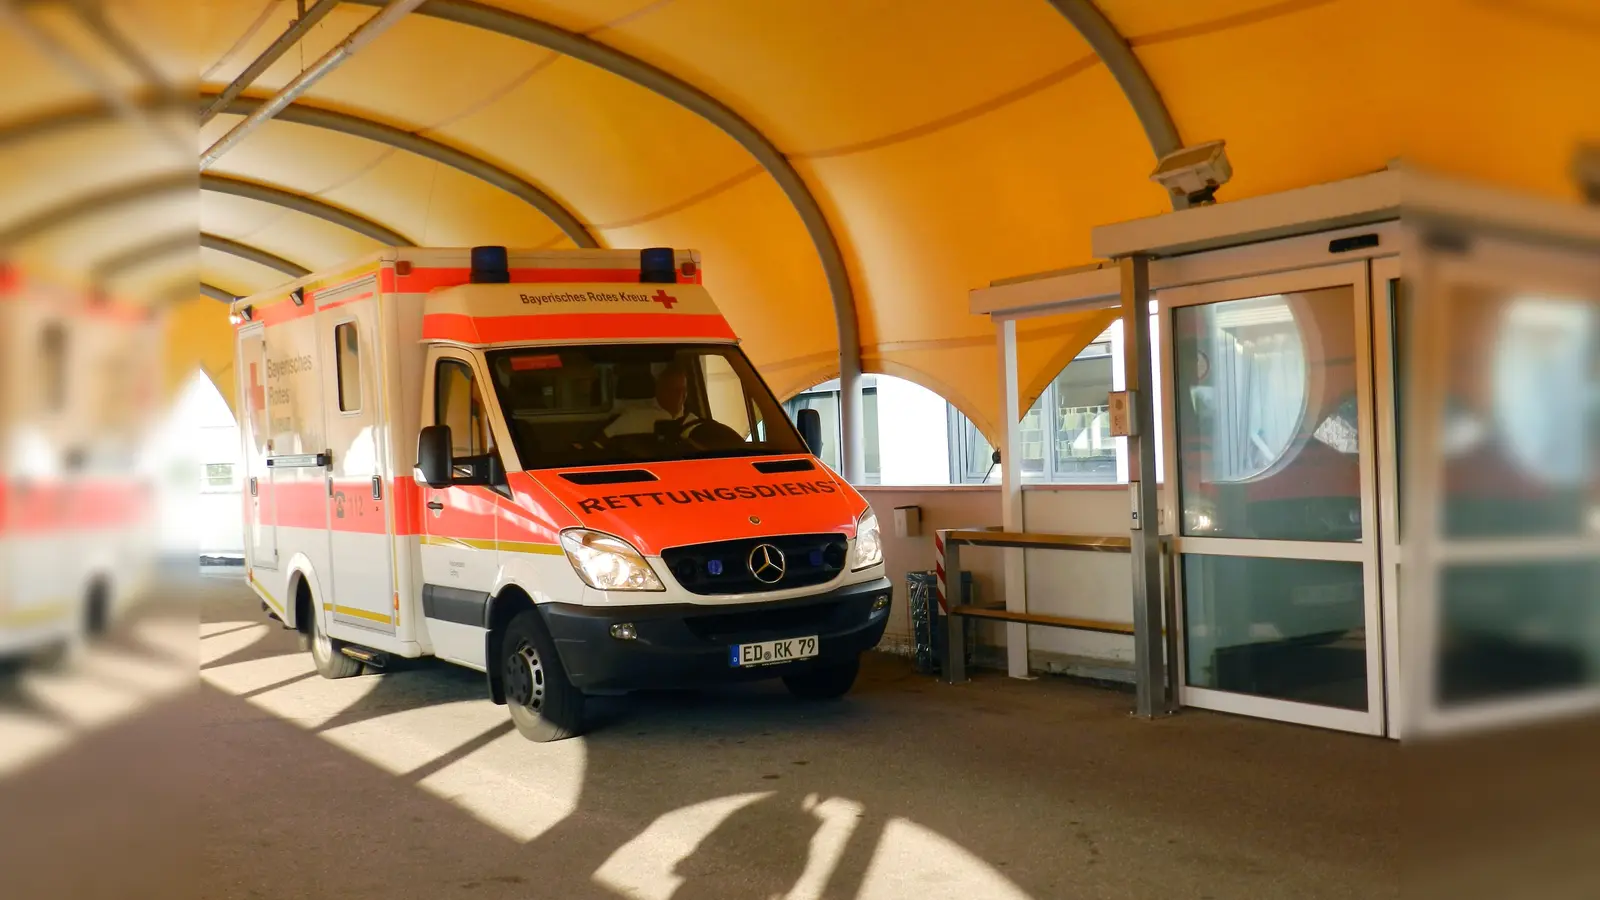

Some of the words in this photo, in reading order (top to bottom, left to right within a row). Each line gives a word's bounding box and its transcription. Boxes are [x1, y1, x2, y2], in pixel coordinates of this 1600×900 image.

[520, 292, 586, 305] Bayerisches
[587, 291, 618, 302] Rotes
[619, 291, 649, 302] Kreuz
[267, 355, 312, 381] Bayerisches
[269, 387, 290, 404] Rotes
[349, 495, 364, 517] 112
[743, 645, 762, 662] ED
[774, 641, 793, 659] RK
[798, 638, 815, 655] 79
